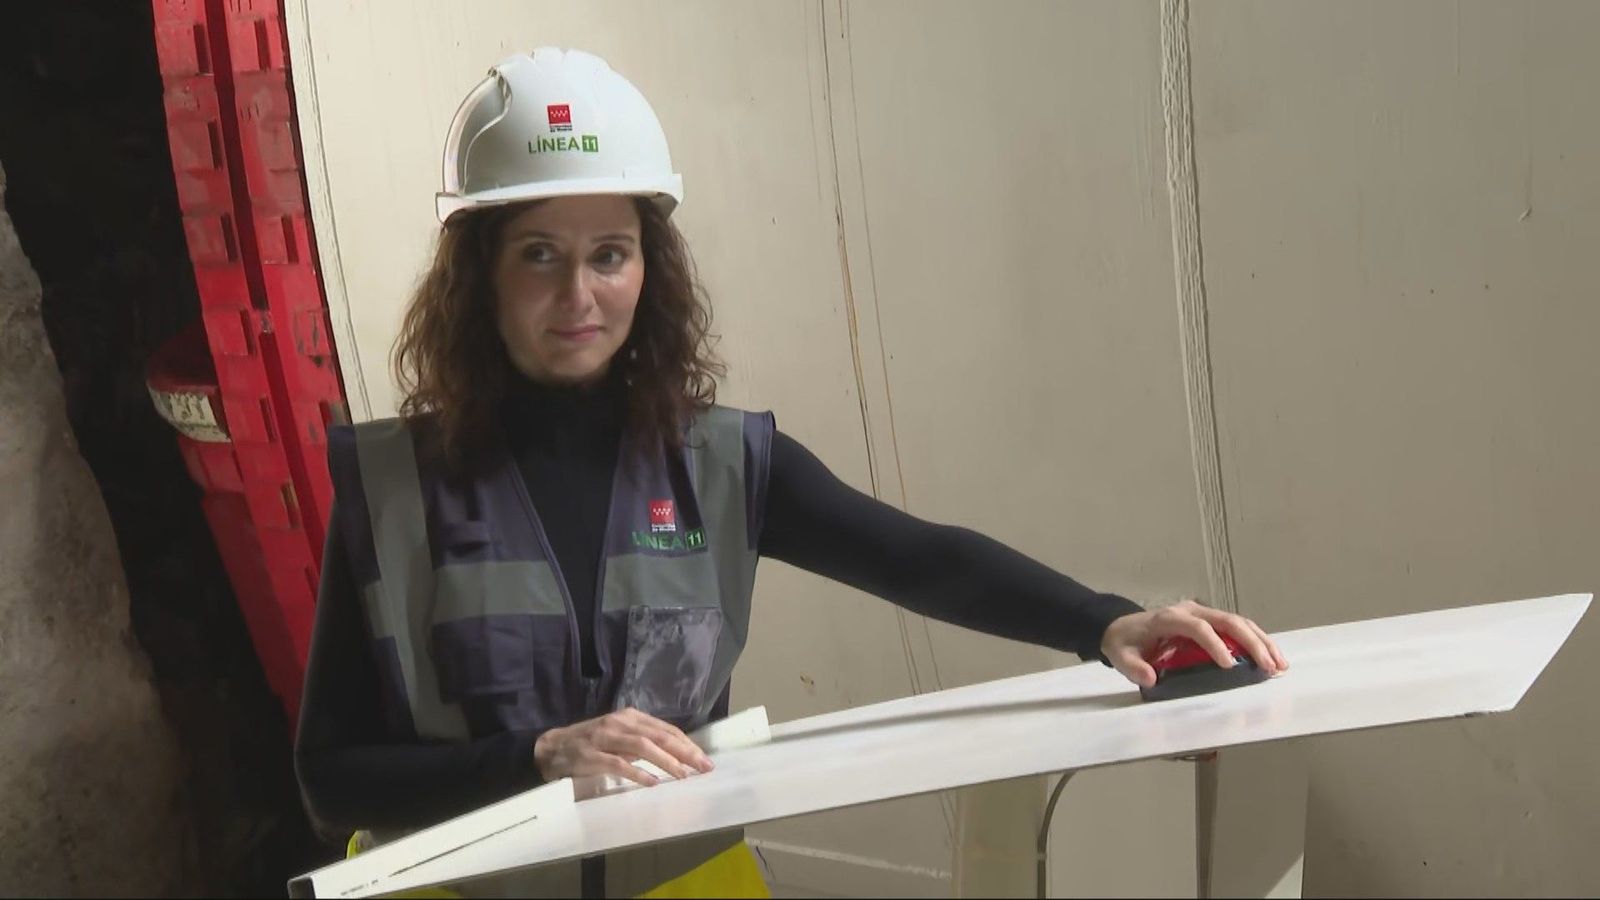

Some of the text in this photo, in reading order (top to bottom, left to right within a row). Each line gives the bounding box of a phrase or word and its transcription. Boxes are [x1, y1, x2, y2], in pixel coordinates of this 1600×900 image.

[528, 135, 597, 154] LÍNEA 11
[688, 532, 702, 546] 11
